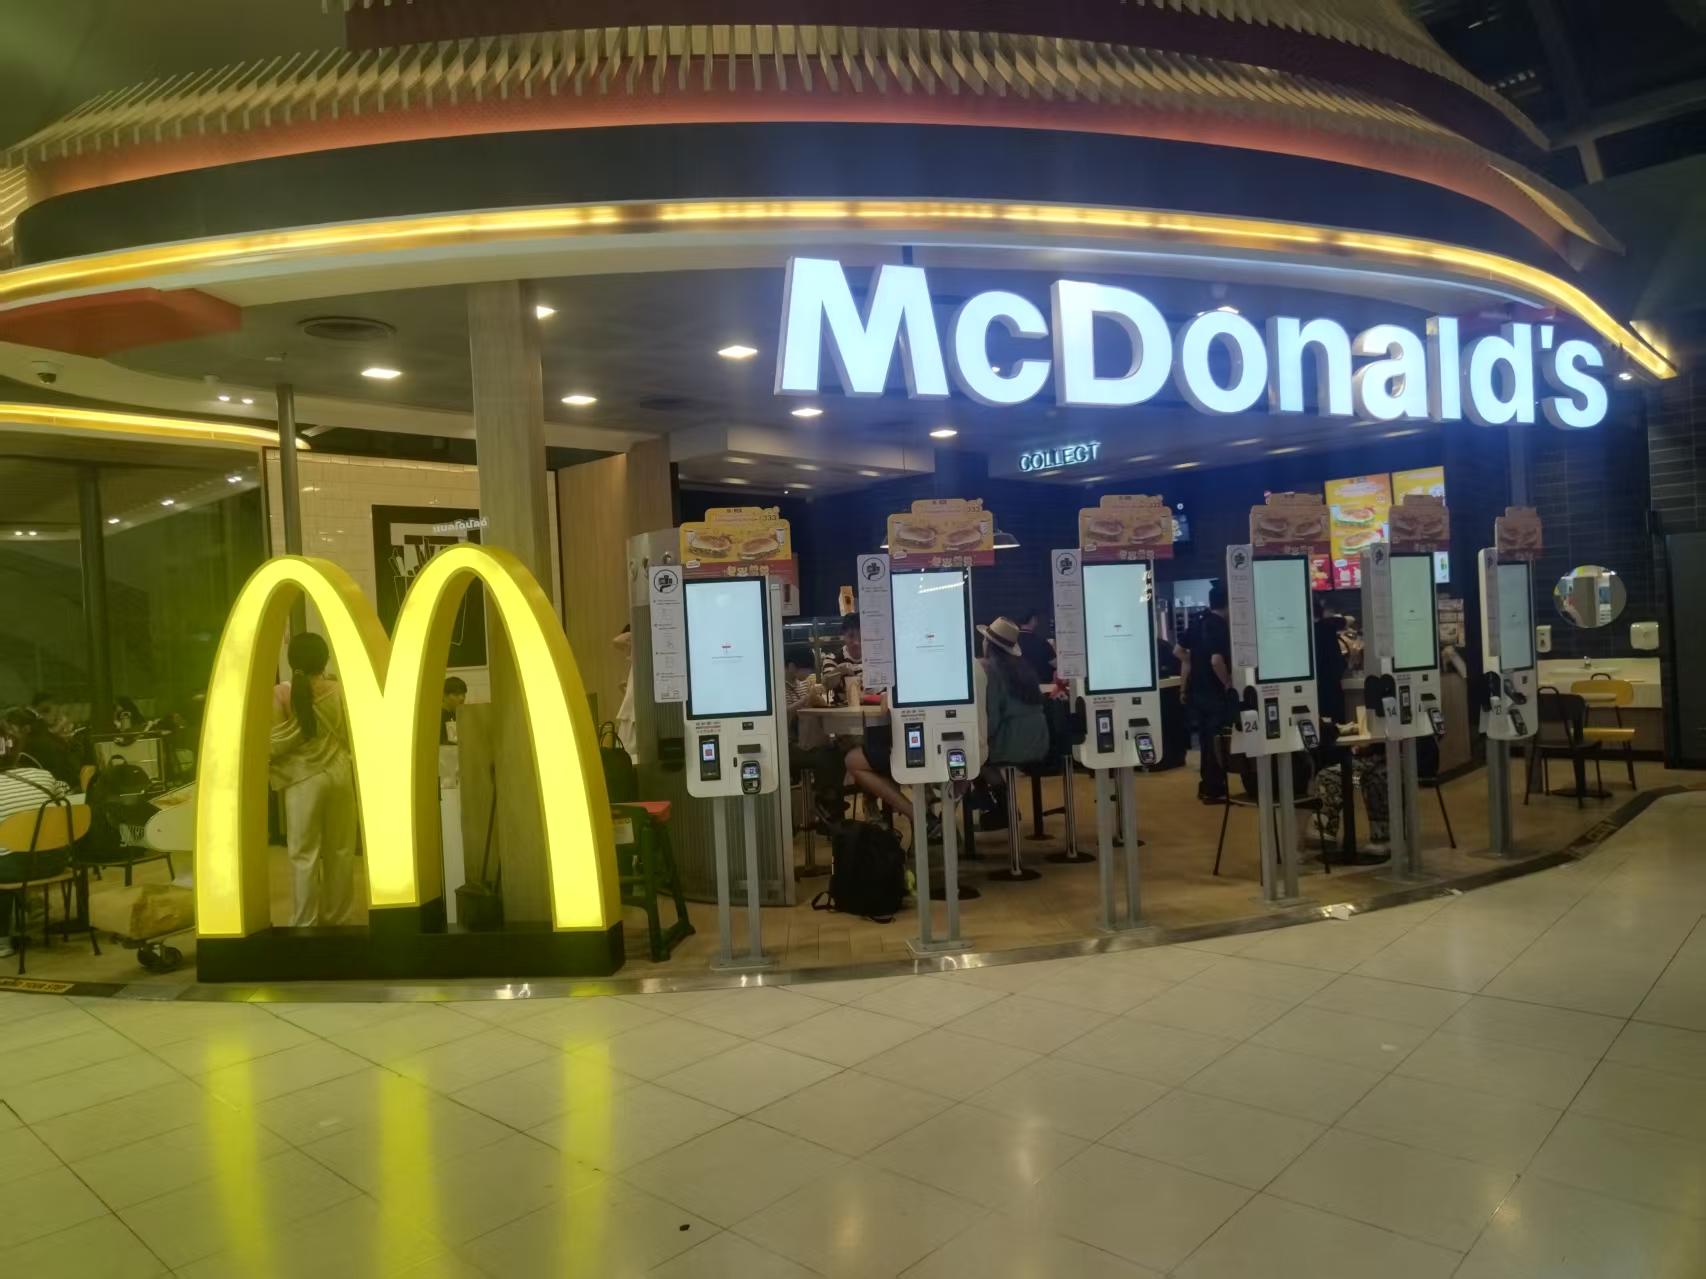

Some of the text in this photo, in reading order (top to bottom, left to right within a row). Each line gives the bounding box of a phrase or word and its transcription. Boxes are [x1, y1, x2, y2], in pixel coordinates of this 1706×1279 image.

[774, 257, 1608, 428] McDonald's
[1019, 441, 1100, 472] COLLECT
[1387, 706, 1397, 717] 14
[1244, 720, 1259, 733] 24
